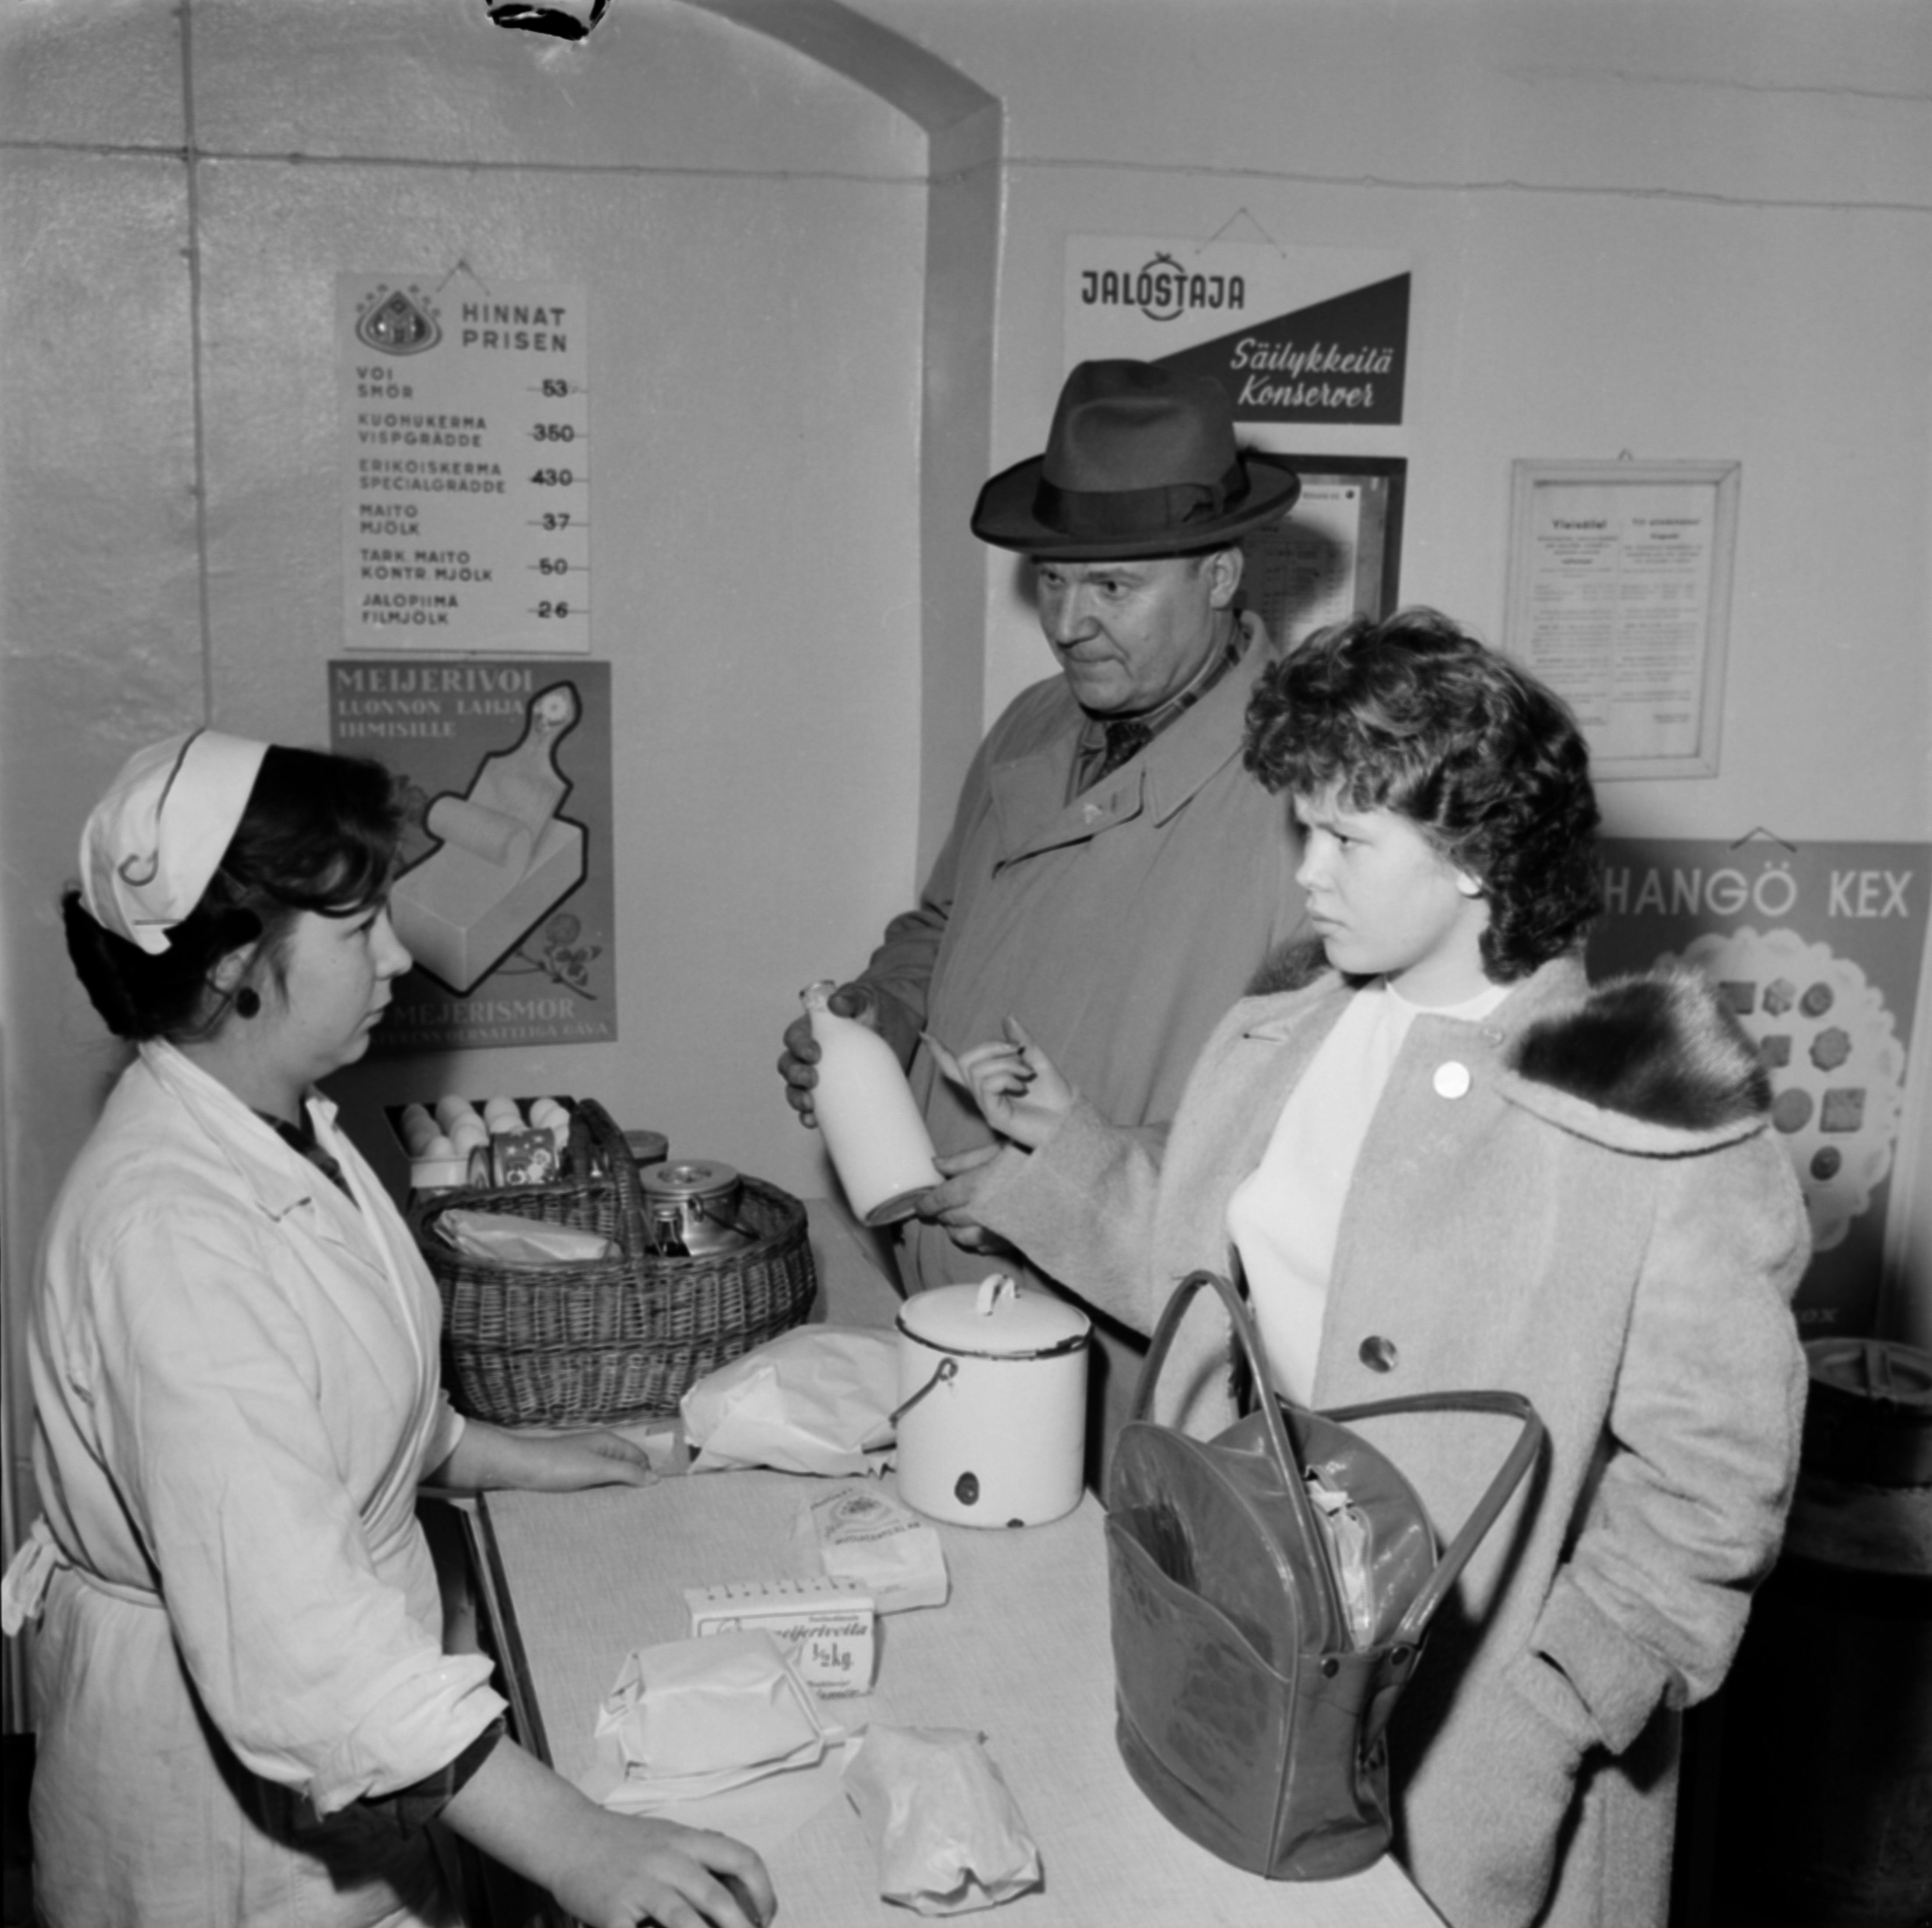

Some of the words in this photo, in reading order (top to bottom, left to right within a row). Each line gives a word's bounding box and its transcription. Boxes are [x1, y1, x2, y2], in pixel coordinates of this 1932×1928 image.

[1081, 270, 1244, 310] JALOSTAJA
[463, 303, 565, 325] HINNAT
[463, 329, 566, 352] PRISEN
[1230, 337, 1394, 378] Säilykkeitä
[356, 367, 392, 380] VOI
[543, 380, 568, 396] 53
[533, 424, 574, 442] 350
[360, 459, 501, 476] ERIKOISKERMA
[531, 469, 572, 485] 430
[360, 504, 417, 518] MAITO
[544, 513, 570, 530] 37
[415, 551, 470, 564] MAITO
[539, 558, 568, 575] 50
[364, 594, 457, 607] JALOPIIMA
[538, 601, 568, 618] 26
[335, 668, 533, 693] MEIJERIVOI
[339, 700, 441, 714] LUONNON
[1604, 860, 1798, 917] HANGÖ
[1829, 870, 1914, 917] KEX
